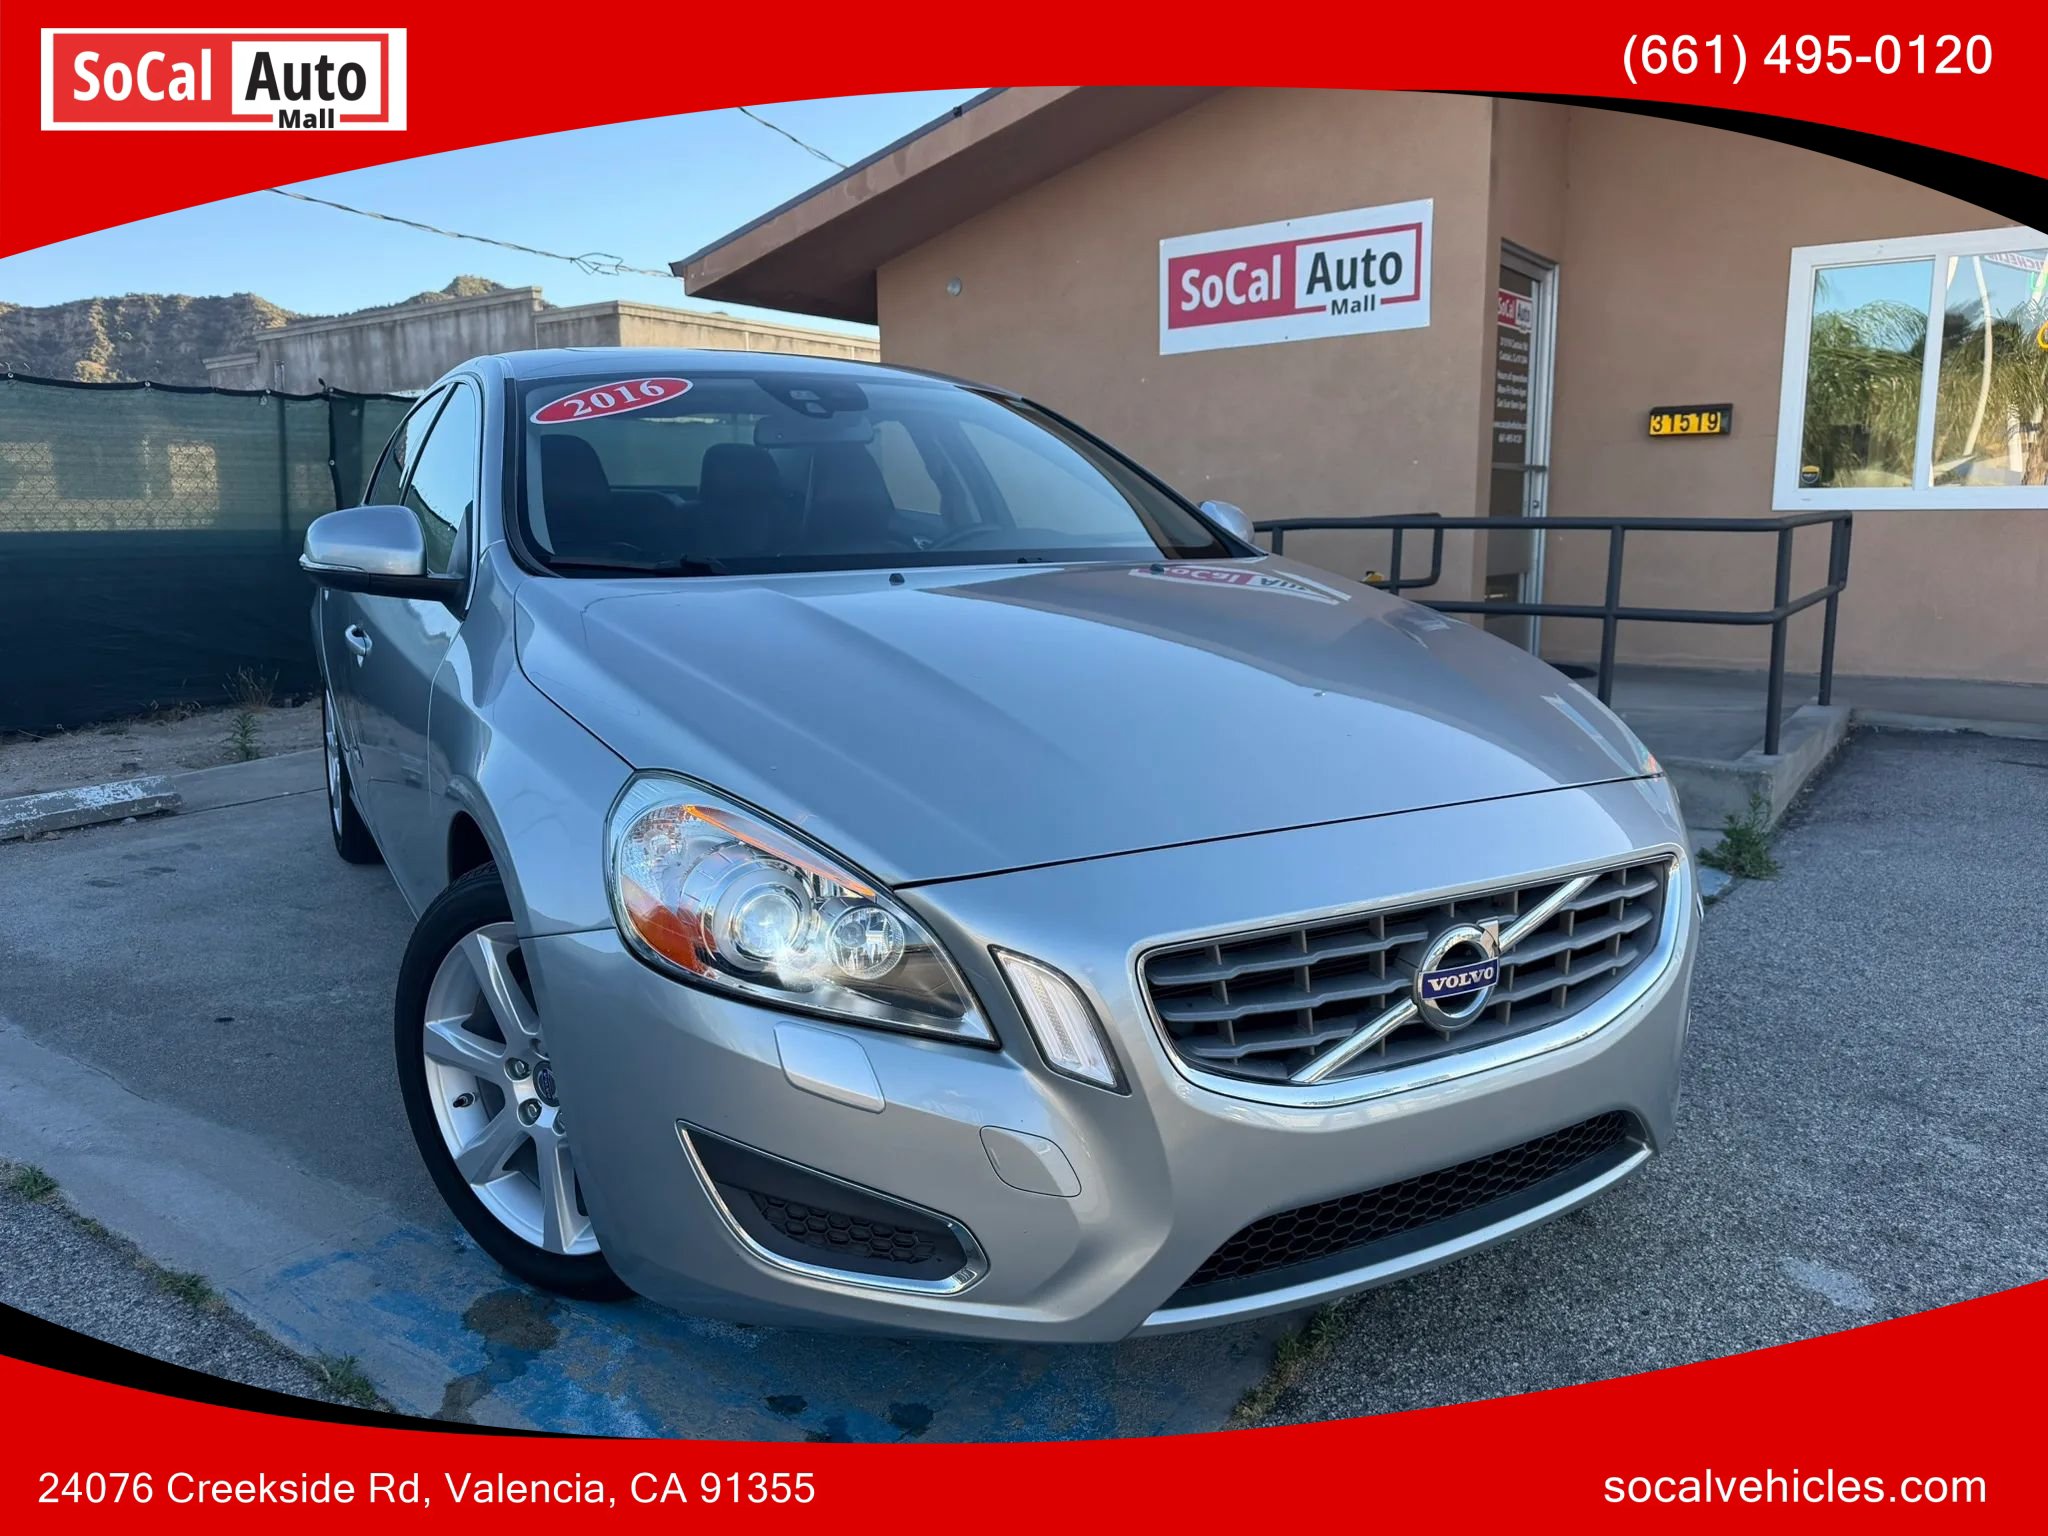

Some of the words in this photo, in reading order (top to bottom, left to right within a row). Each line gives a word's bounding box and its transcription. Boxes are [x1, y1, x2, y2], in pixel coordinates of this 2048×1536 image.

[1181, 254, 1282, 311] SoCal
[1306, 247, 1402, 295] Auto
[1331, 295, 1375, 316] Mall
[563, 379, 665, 417] 2016
[1652, 412, 1719, 432] 31519
[1428, 966, 1495, 992] VOLVO
